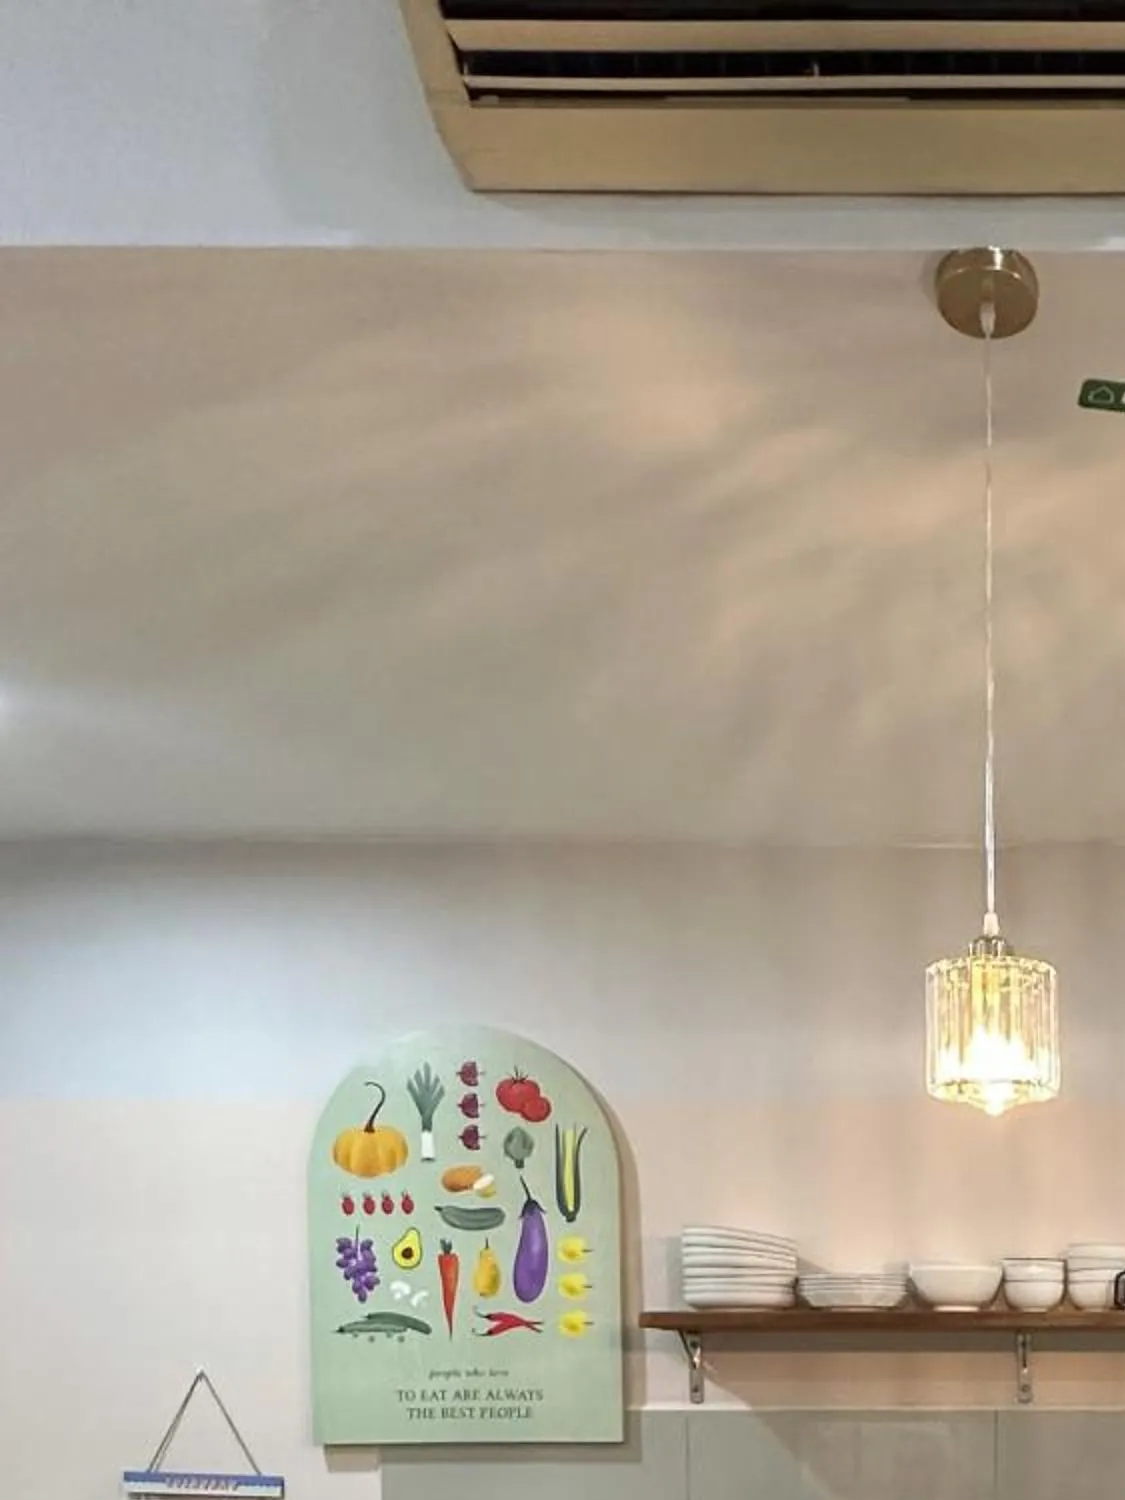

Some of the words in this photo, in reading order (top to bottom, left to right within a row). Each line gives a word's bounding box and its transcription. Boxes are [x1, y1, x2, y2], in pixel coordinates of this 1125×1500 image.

[397, 1389, 416, 1402] TO
[421, 1389, 447, 1402] EAT
[453, 1389, 481, 1402] ARE
[485, 1389, 544, 1402] ALWAYS
[407, 1407, 437, 1420] THE
[441, 1407, 475, 1419] BEST
[479, 1407, 532, 1419] PEOPLE
